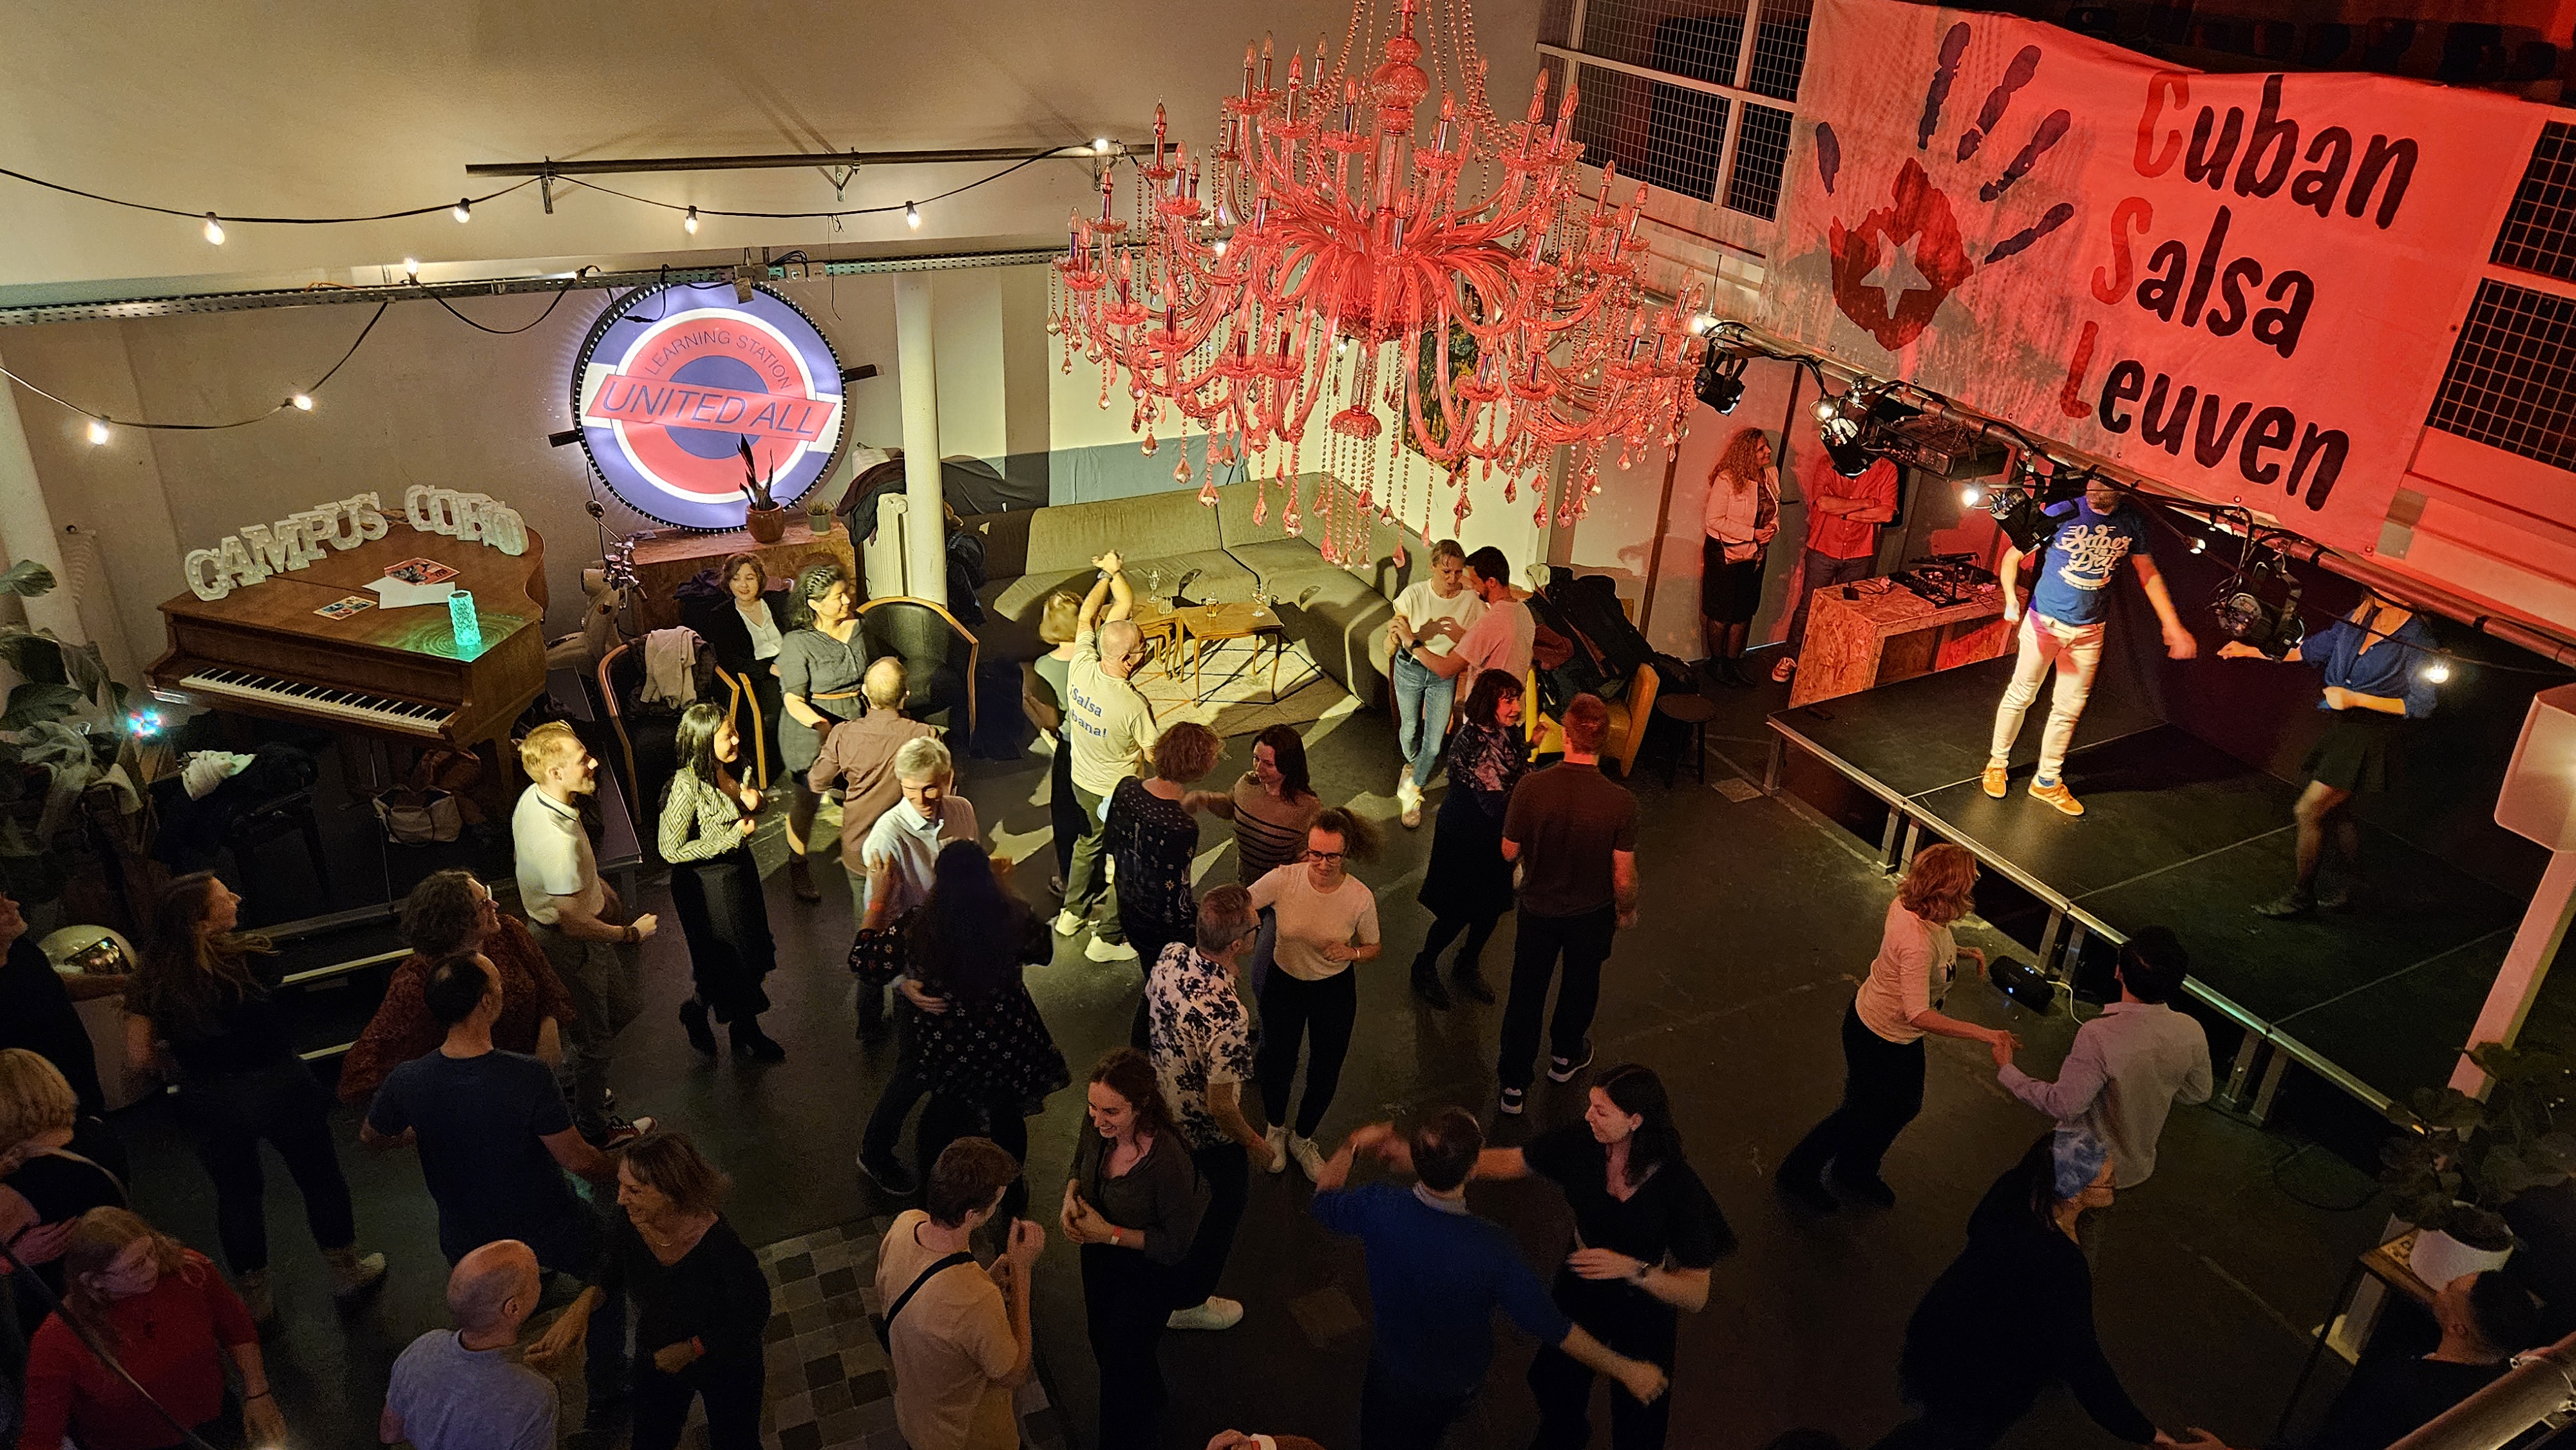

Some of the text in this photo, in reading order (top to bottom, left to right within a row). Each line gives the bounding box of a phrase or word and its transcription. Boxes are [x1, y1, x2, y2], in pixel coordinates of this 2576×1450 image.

[2133, 70, 2419, 230] Cuban
[2090, 196, 2315, 359] Salsa
[603, 381, 813, 435] UNITED ALL
[645, 330, 792, 390] LEARNING STATION
[2059, 320, 2350, 511] Leuven
[184, 491, 388, 602] CAMPUS
[1070, 708, 1107, 739] bana!
